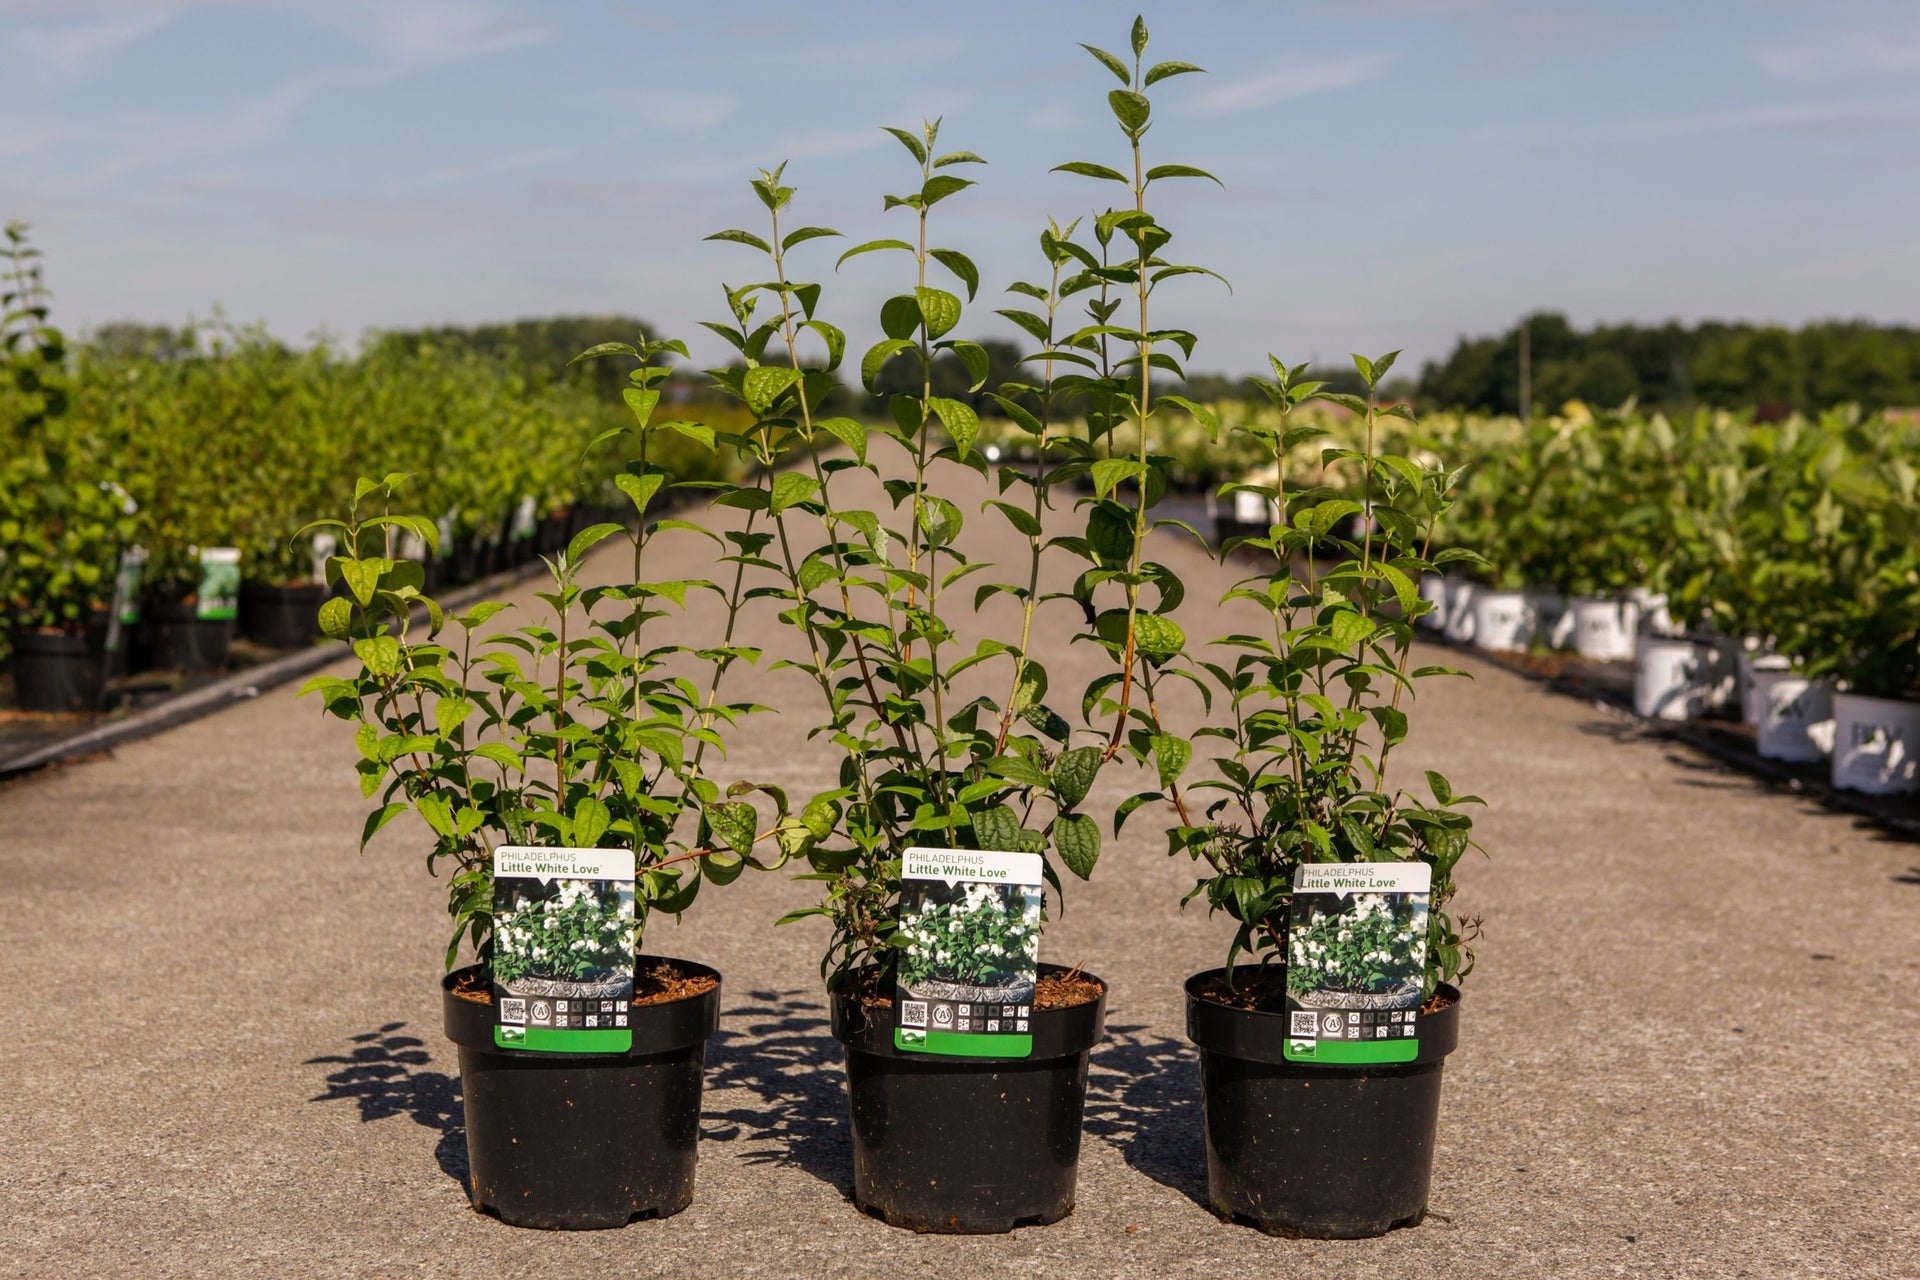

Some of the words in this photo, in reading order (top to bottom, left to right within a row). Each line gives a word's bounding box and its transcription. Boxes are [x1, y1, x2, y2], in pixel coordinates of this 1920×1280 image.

[501, 852, 576, 862] PHILADELPHUS
[909, 853, 984, 865] PHILADELPHUS
[501, 862, 532, 873] Little
[535, 863, 569, 874] White
[572, 864, 599, 874] Love
[909, 864, 939, 875] Little
[943, 865, 976, 877] White
[979, 867, 1007, 878] Love
[1302, 868, 1374, 877] PHILADELPHUS
[1301, 878, 1330, 888] Little
[1333, 878, 1366, 888] White
[1369, 878, 1396, 888] Love
